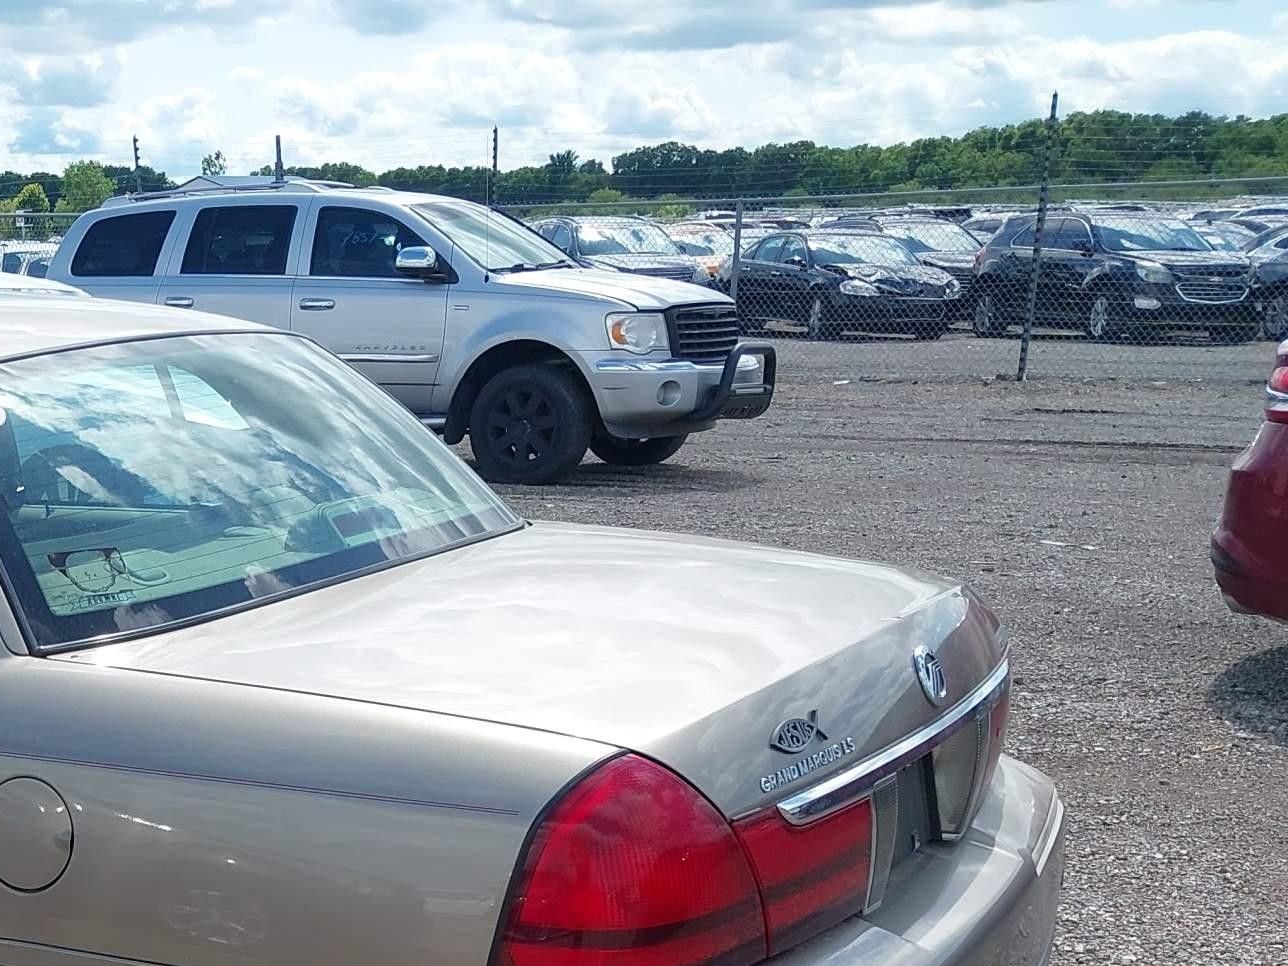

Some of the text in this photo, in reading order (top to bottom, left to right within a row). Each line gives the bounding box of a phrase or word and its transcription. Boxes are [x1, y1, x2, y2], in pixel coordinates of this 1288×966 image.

[777, 721, 813, 748] JESUS
[759, 736, 856, 793] GRAND MARQUIS LS
